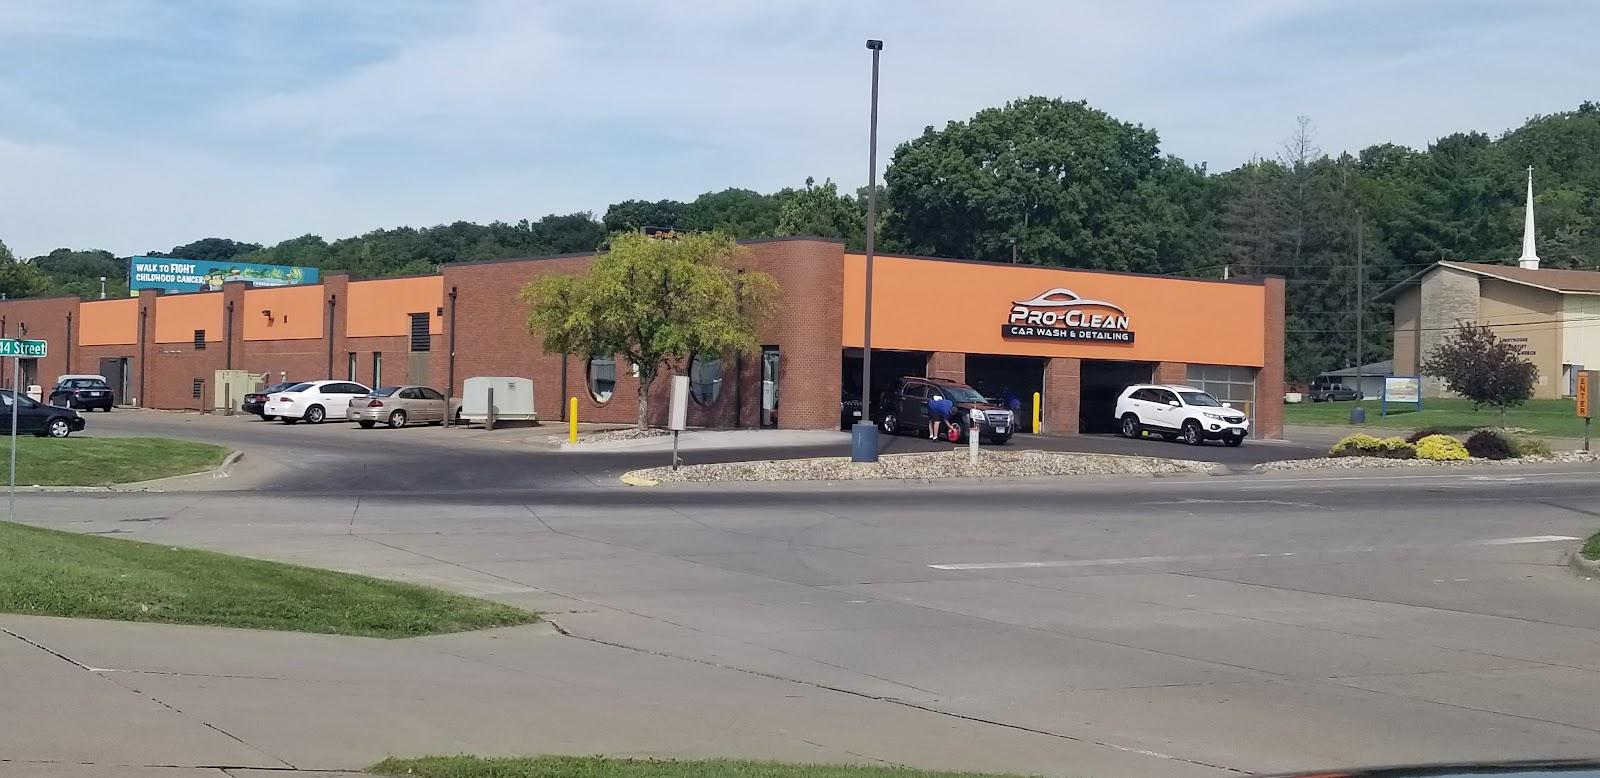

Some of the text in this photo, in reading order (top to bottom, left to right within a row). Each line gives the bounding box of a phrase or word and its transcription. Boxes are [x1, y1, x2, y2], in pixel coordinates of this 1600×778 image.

[136, 263, 196, 274] WALK TO FIGHT
[136, 273, 176, 283] CHILDHOOD
[1010, 306, 1130, 330] PRO-CLEAN
[1010, 326, 1129, 341] CAR WASH & DETAILING
[13, 341, 46, 355] Street
